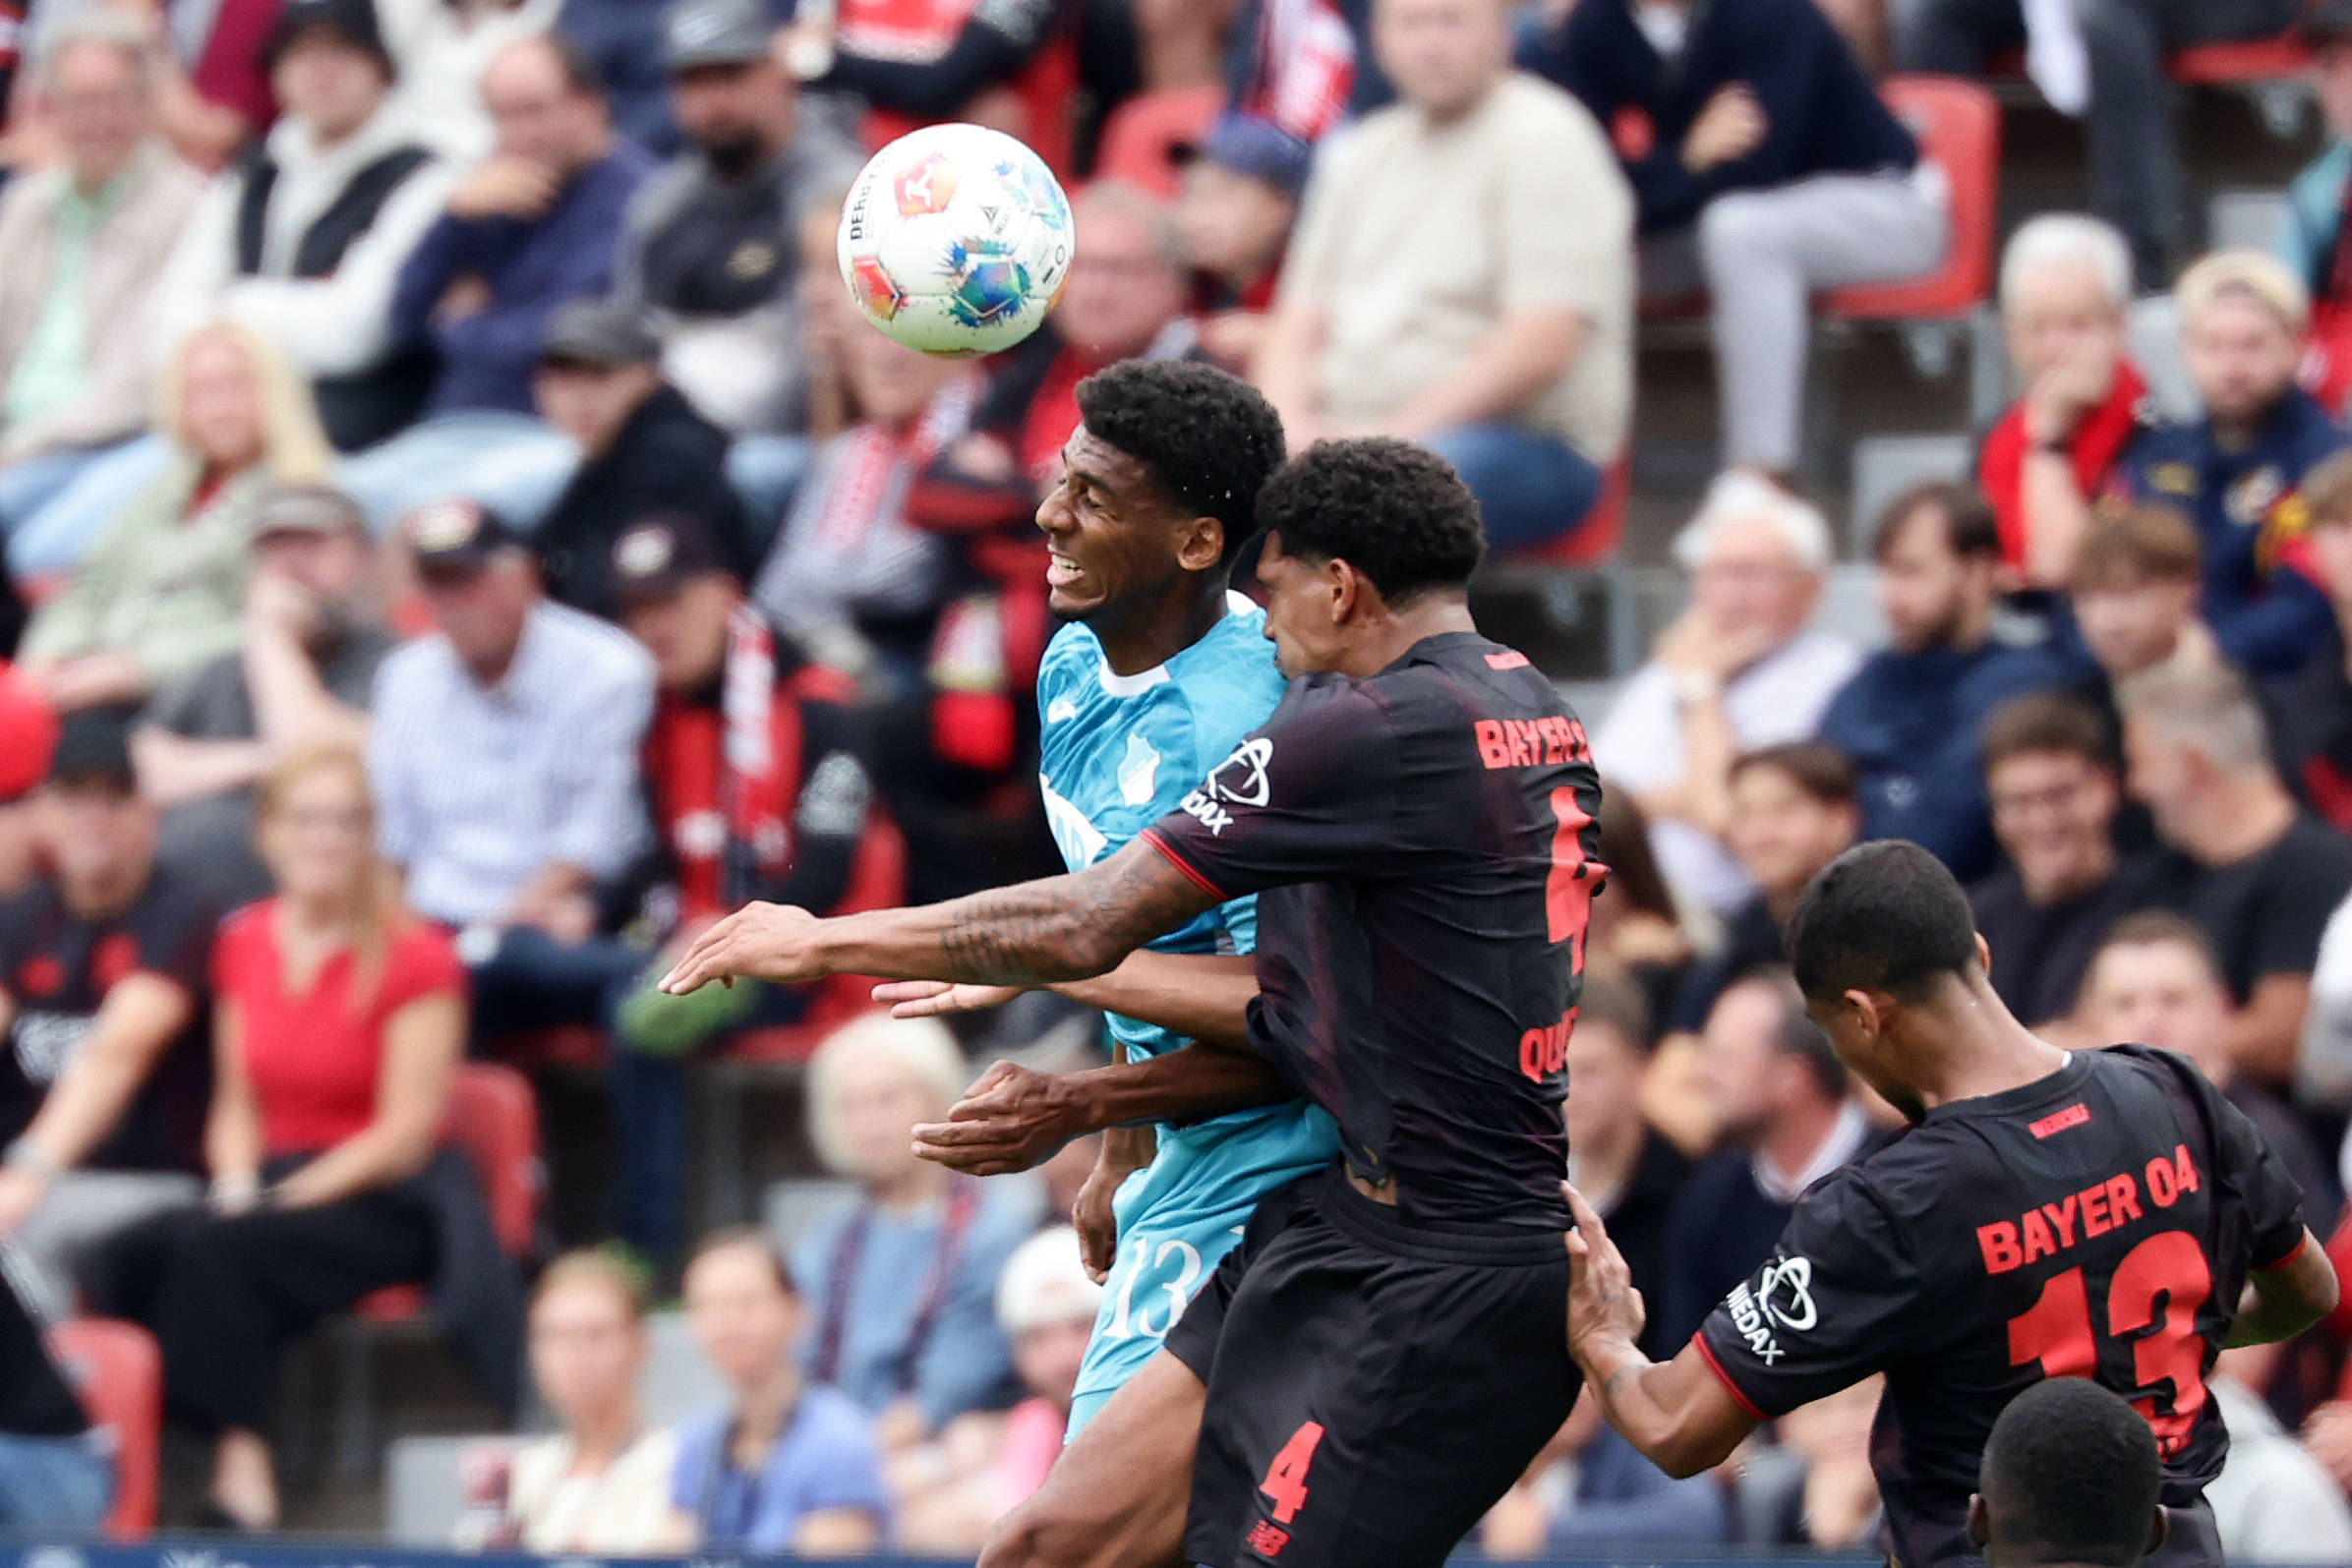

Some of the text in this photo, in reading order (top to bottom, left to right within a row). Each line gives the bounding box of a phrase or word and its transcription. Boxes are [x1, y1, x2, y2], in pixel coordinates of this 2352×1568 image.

[1975, 1143, 2200, 1275] BAYER 04
[1102, 1237, 1202, 1339] 13
[2007, 1230, 2211, 1461] 13
[1259, 1420, 1325, 1524] 4
